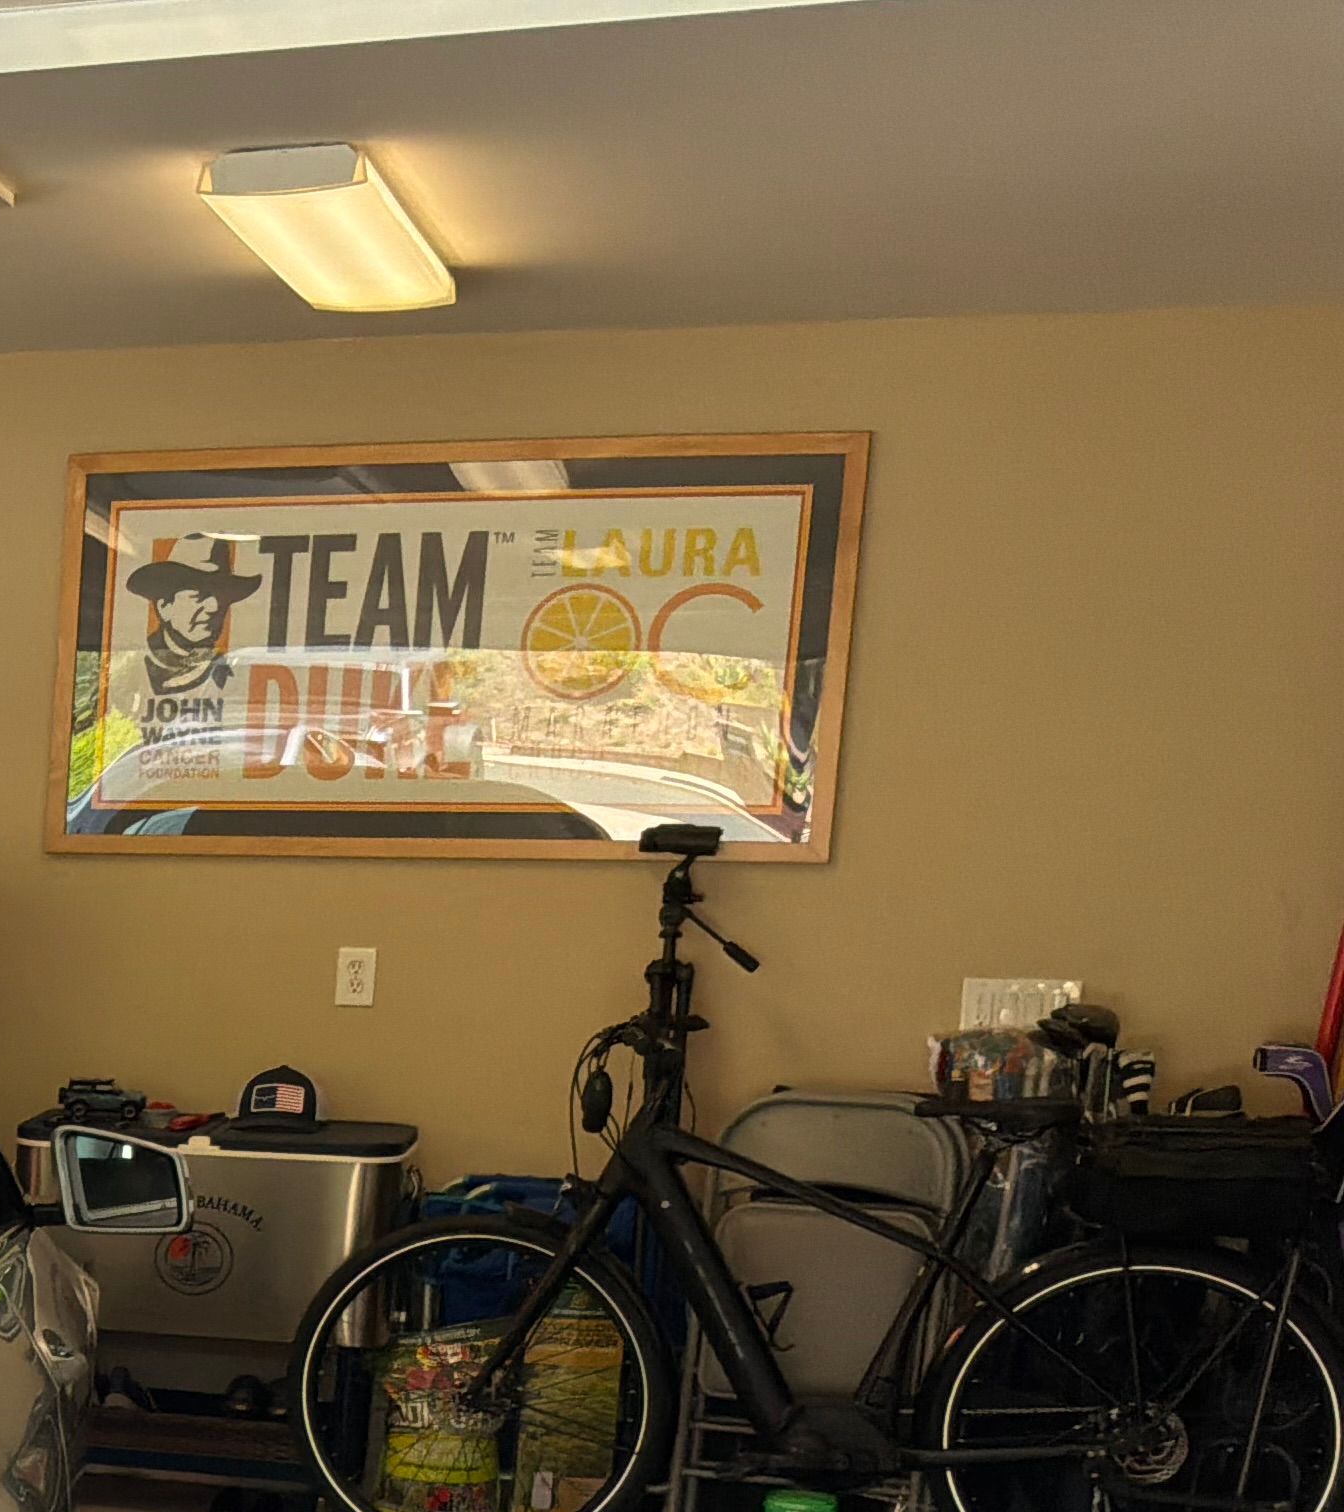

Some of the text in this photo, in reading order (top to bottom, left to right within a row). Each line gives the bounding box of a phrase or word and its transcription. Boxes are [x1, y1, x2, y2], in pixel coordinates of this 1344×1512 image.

[530, 529, 560, 579] TEAM
[562, 527, 762, 578] LAURA
[258, 530, 490, 653] TEAM
[141, 697, 224, 723] JOHN
[242, 661, 473, 781] DUKE
[139, 748, 221, 766] CANCER
[139, 767, 221, 780] FOUNDATION
[196, 1195, 264, 1232] BAHAMA
